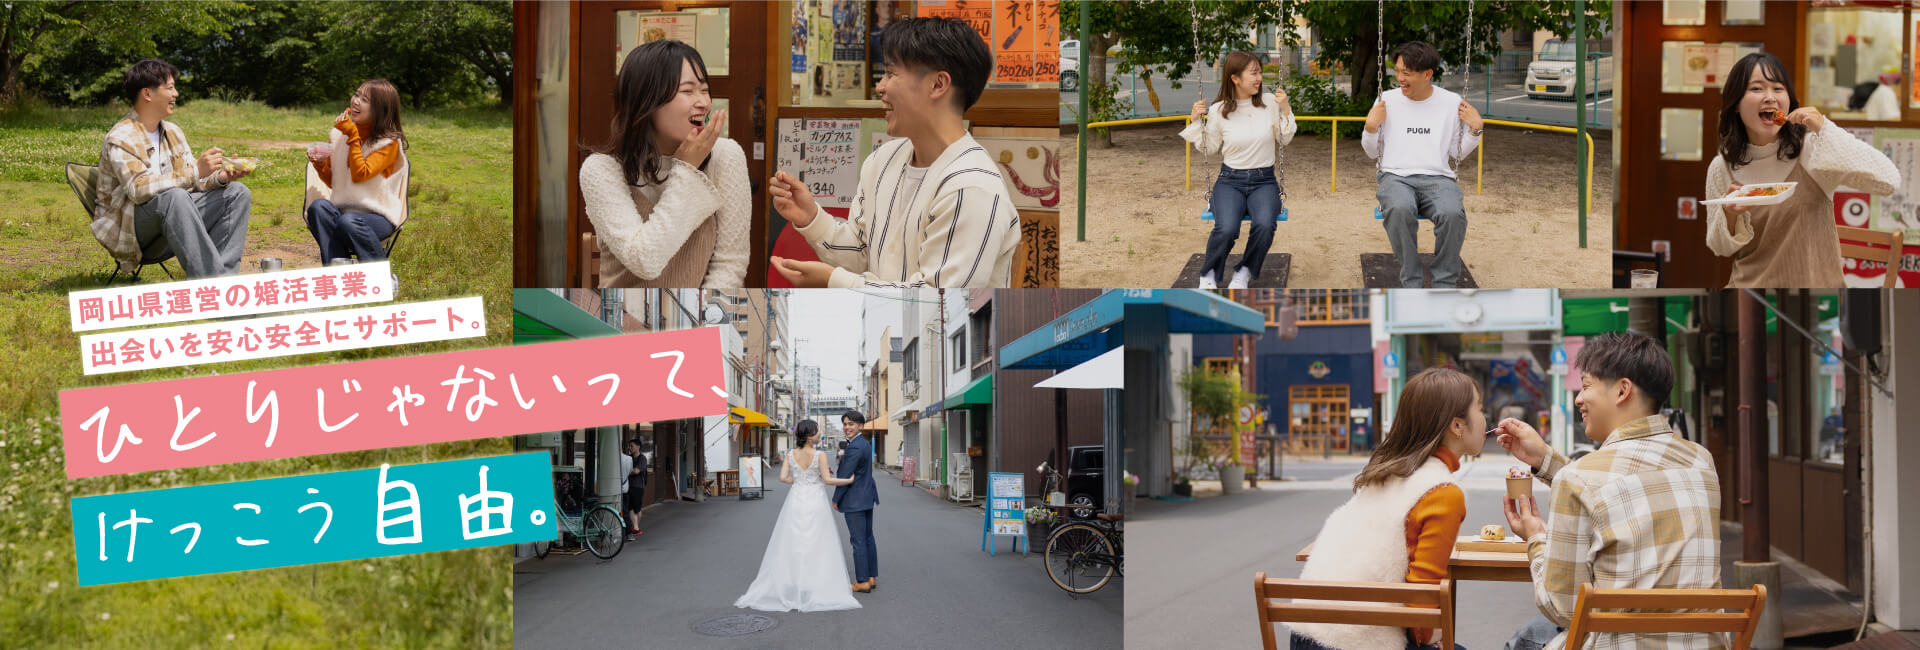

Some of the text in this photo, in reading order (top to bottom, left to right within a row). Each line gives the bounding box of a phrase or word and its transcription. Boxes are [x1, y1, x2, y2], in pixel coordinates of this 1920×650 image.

[1036, 61, 1056, 76] 250
[811, 130, 853, 143] カップアイス
